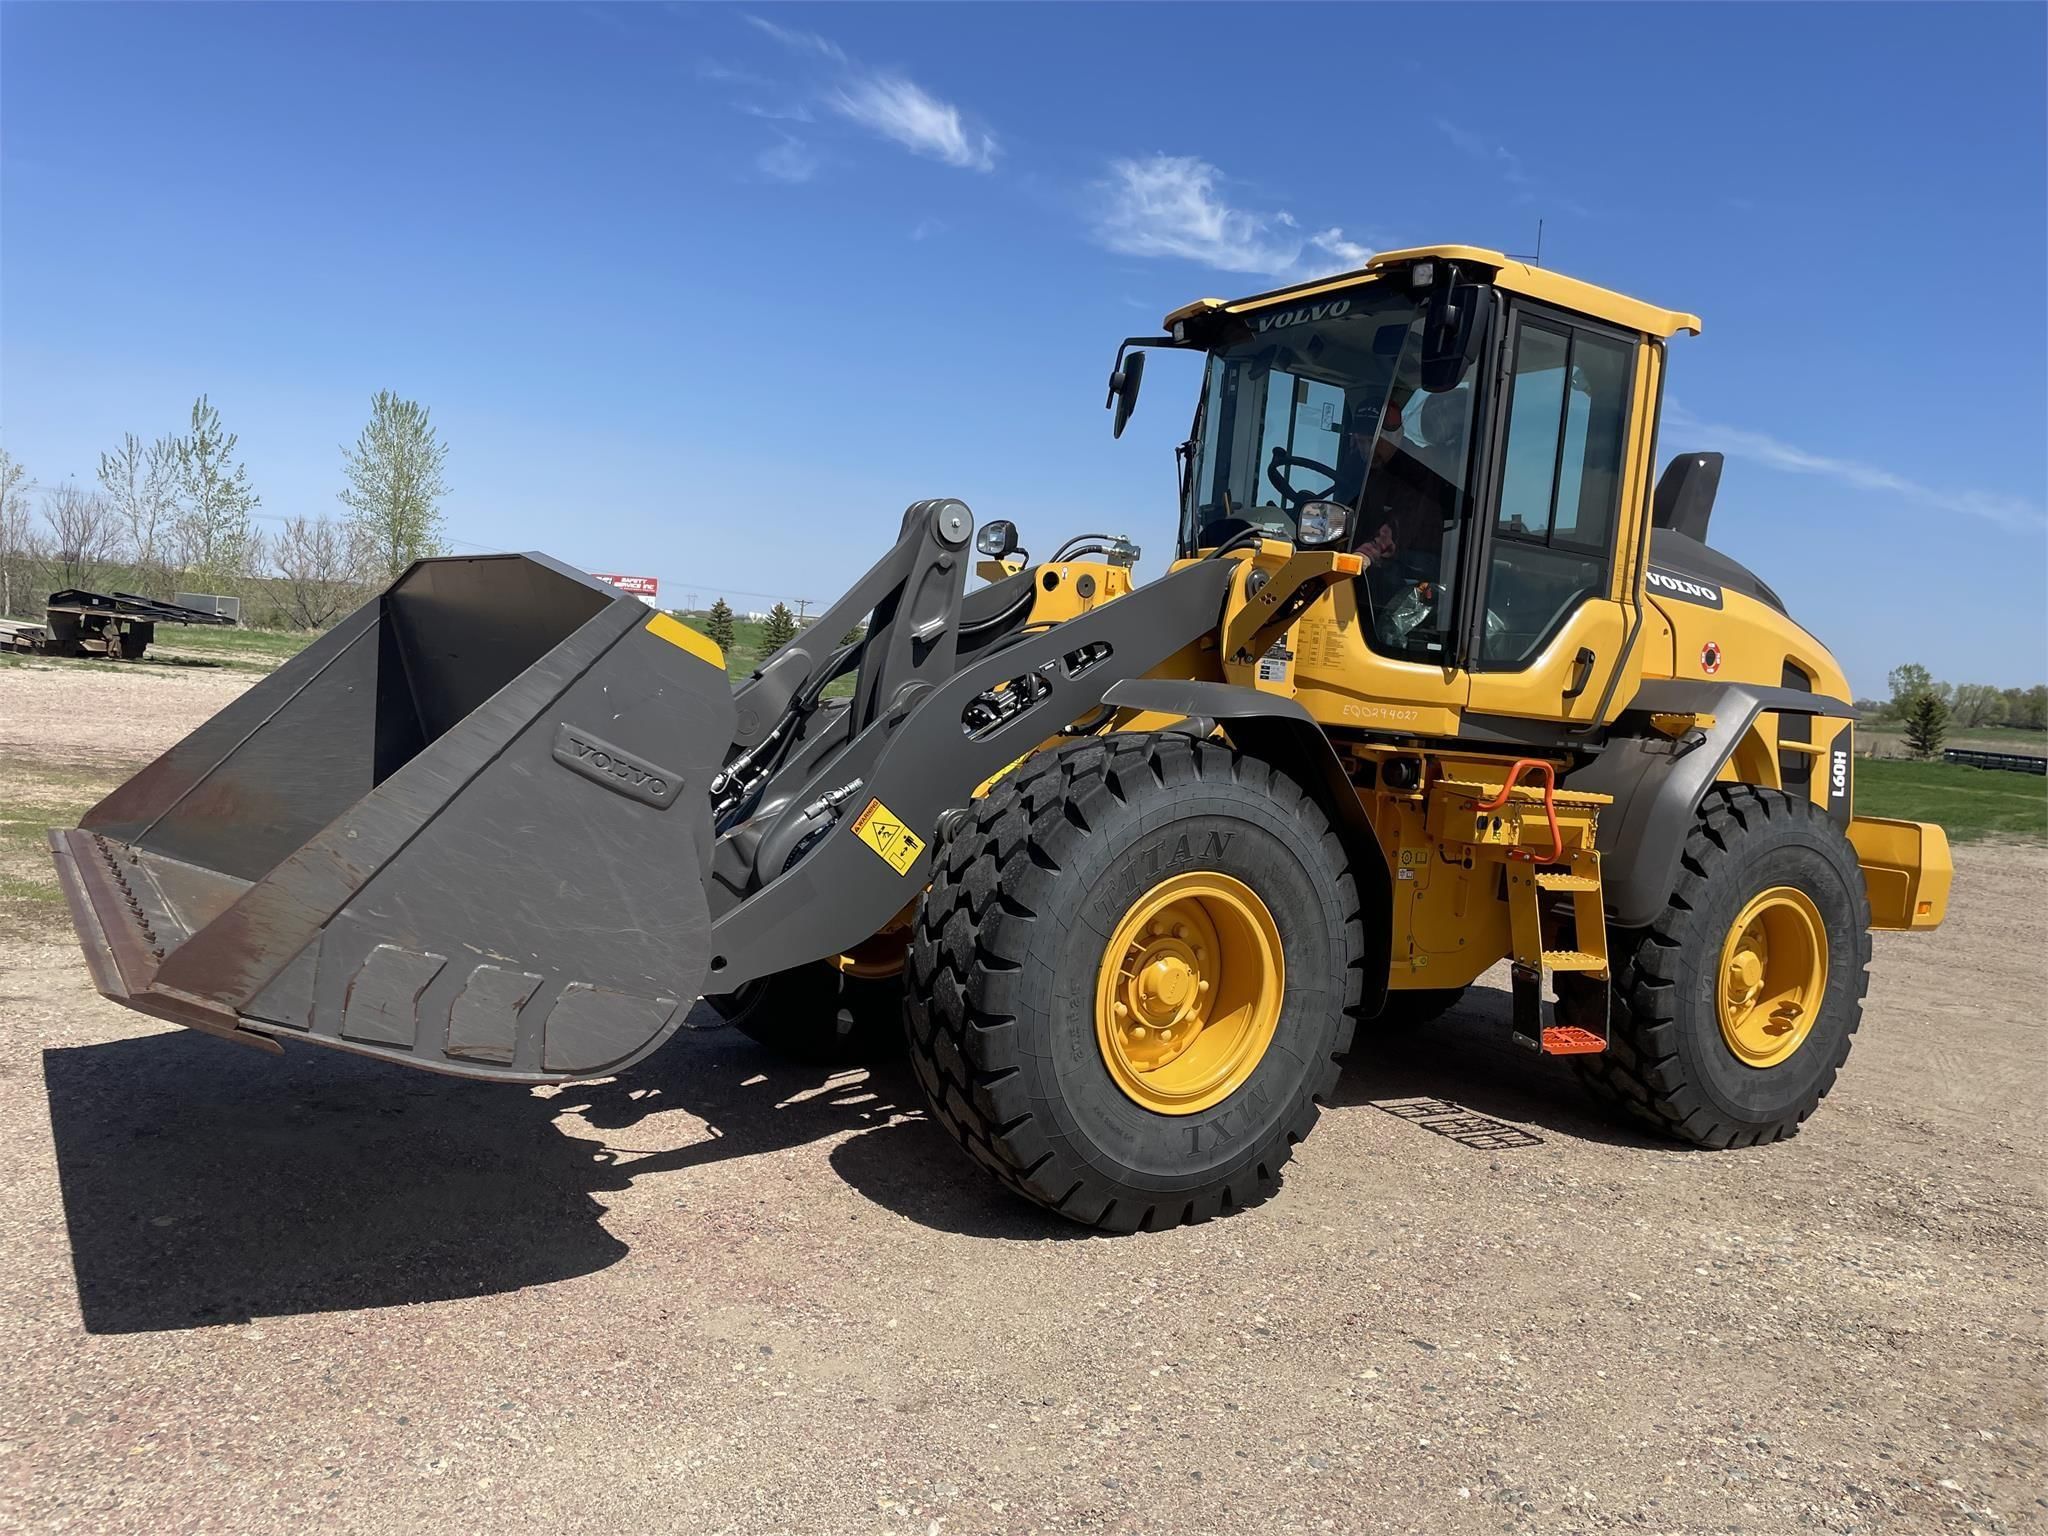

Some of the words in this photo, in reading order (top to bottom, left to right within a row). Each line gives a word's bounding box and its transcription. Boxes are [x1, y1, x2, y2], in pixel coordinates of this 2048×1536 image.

[1258, 299, 1351, 333] VOLVO
[1645, 571, 1717, 601] VOLVO
[569, 736, 669, 796] VOLVO
[1832, 750, 1847, 797] L60H
[858, 800, 878, 827] WARNING
[1094, 831, 1237, 922] TITAN
[1182, 1079, 1273, 1160] MXL
